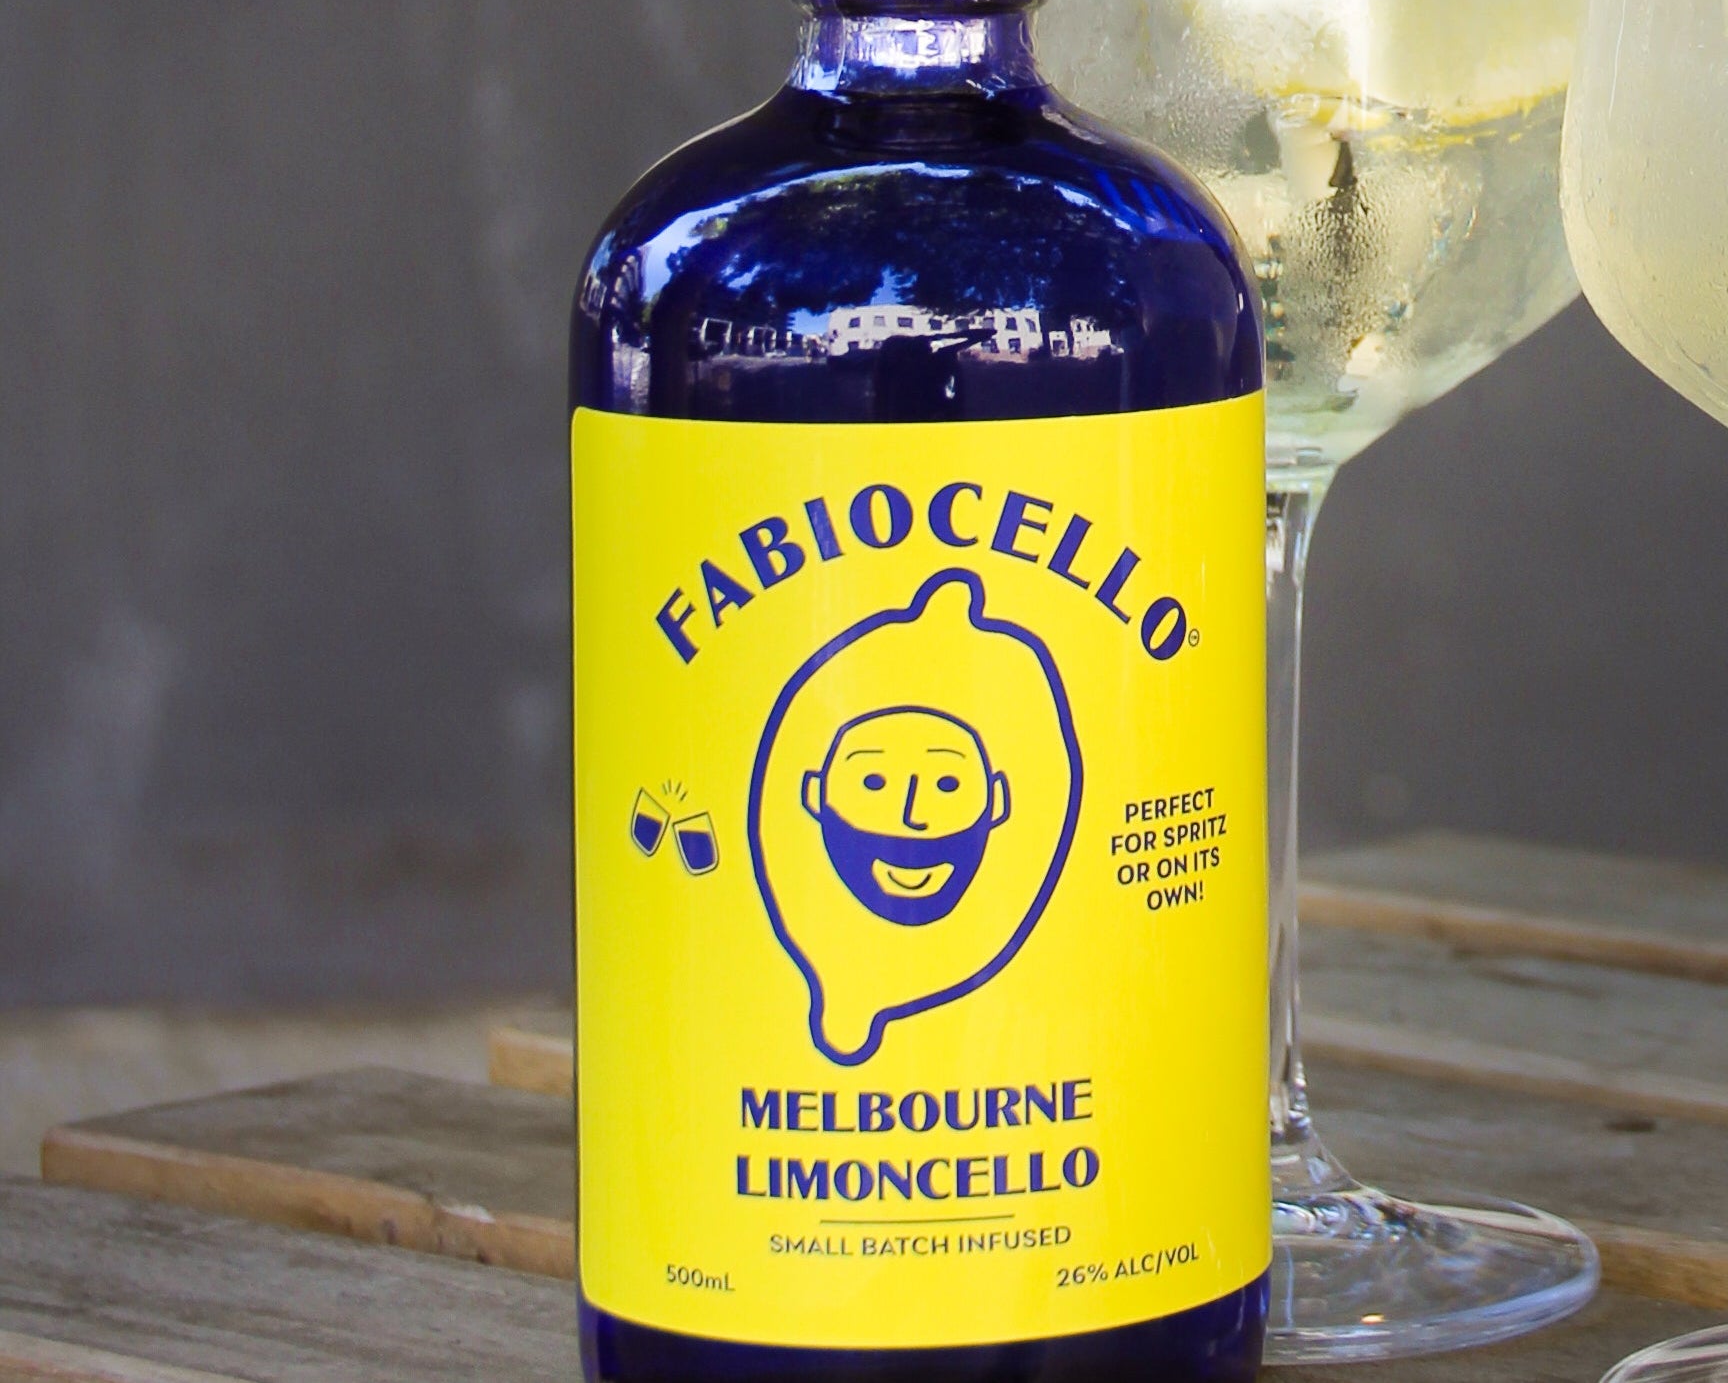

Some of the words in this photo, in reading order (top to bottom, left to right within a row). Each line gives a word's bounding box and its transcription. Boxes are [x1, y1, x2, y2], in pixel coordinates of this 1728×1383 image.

[654, 482, 1187, 666] FABIOCELLO
[1124, 787, 1215, 824] PERFECT
[1110, 830, 1157, 856] FOR
[1163, 814, 1227, 848] SPRITZ
[1117, 862, 1150, 886] OR
[1156, 854, 1188, 879] ON
[1193, 846, 1221, 872] ITS
[1146, 880, 1204, 911] OWN!
[741, 1078, 1093, 1133] MELBOURNE
[736, 1146, 1100, 1202] LIMONCELLO
[769, 1234, 854, 1257] SMALL
[861, 1234, 950, 1257] BATCH
[957, 1226, 1072, 1253] INFUSED
[665, 1263, 736, 1293] 500mL
[1056, 1265, 1109, 1288] 26%
[1113, 1241, 1200, 1281] ALC/VOL
